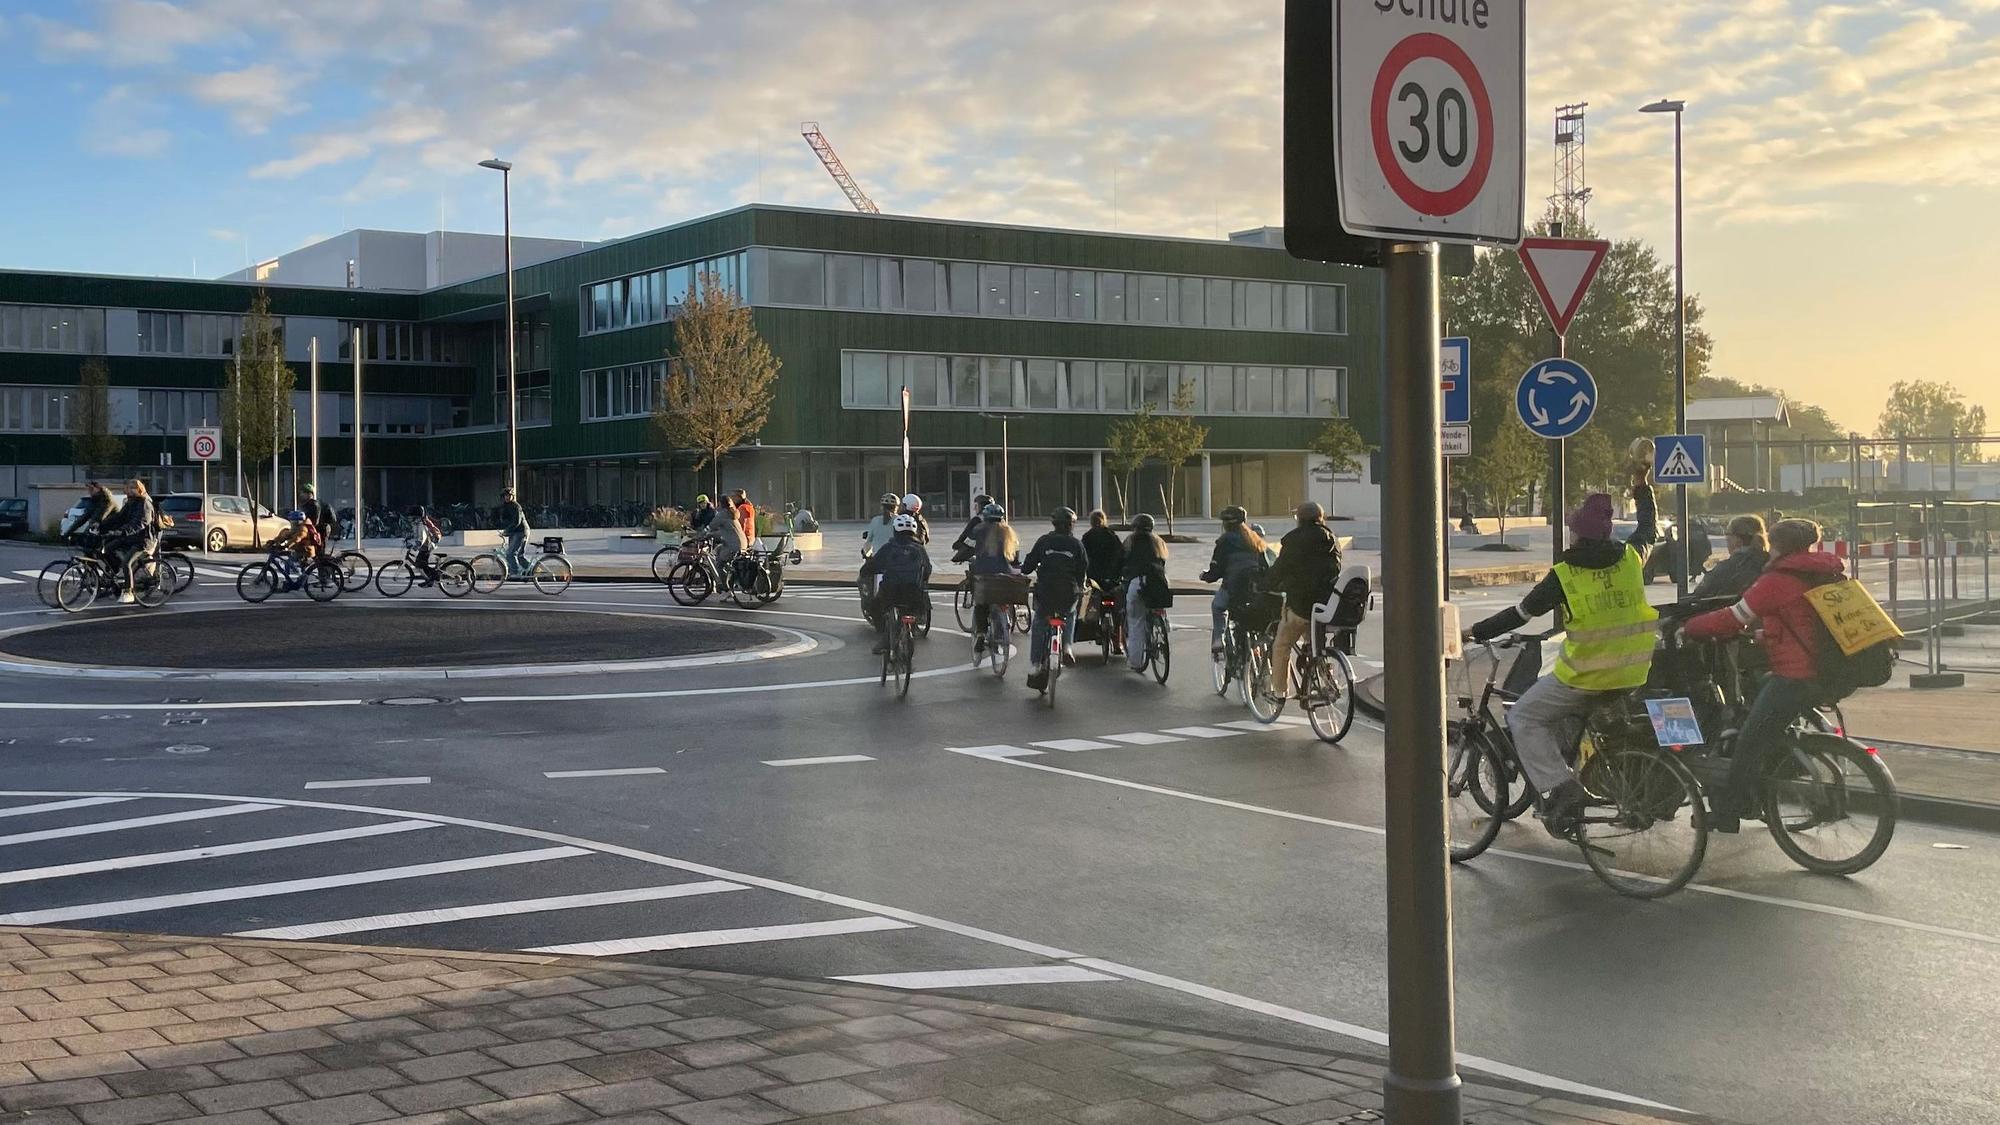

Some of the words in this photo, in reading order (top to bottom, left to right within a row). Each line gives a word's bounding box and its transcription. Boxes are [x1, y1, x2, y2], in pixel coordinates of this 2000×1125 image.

[1374, 0, 1489, 29] cule
[1398, 82, 1468, 168] 30
[198, 441, 211, 452] 30
